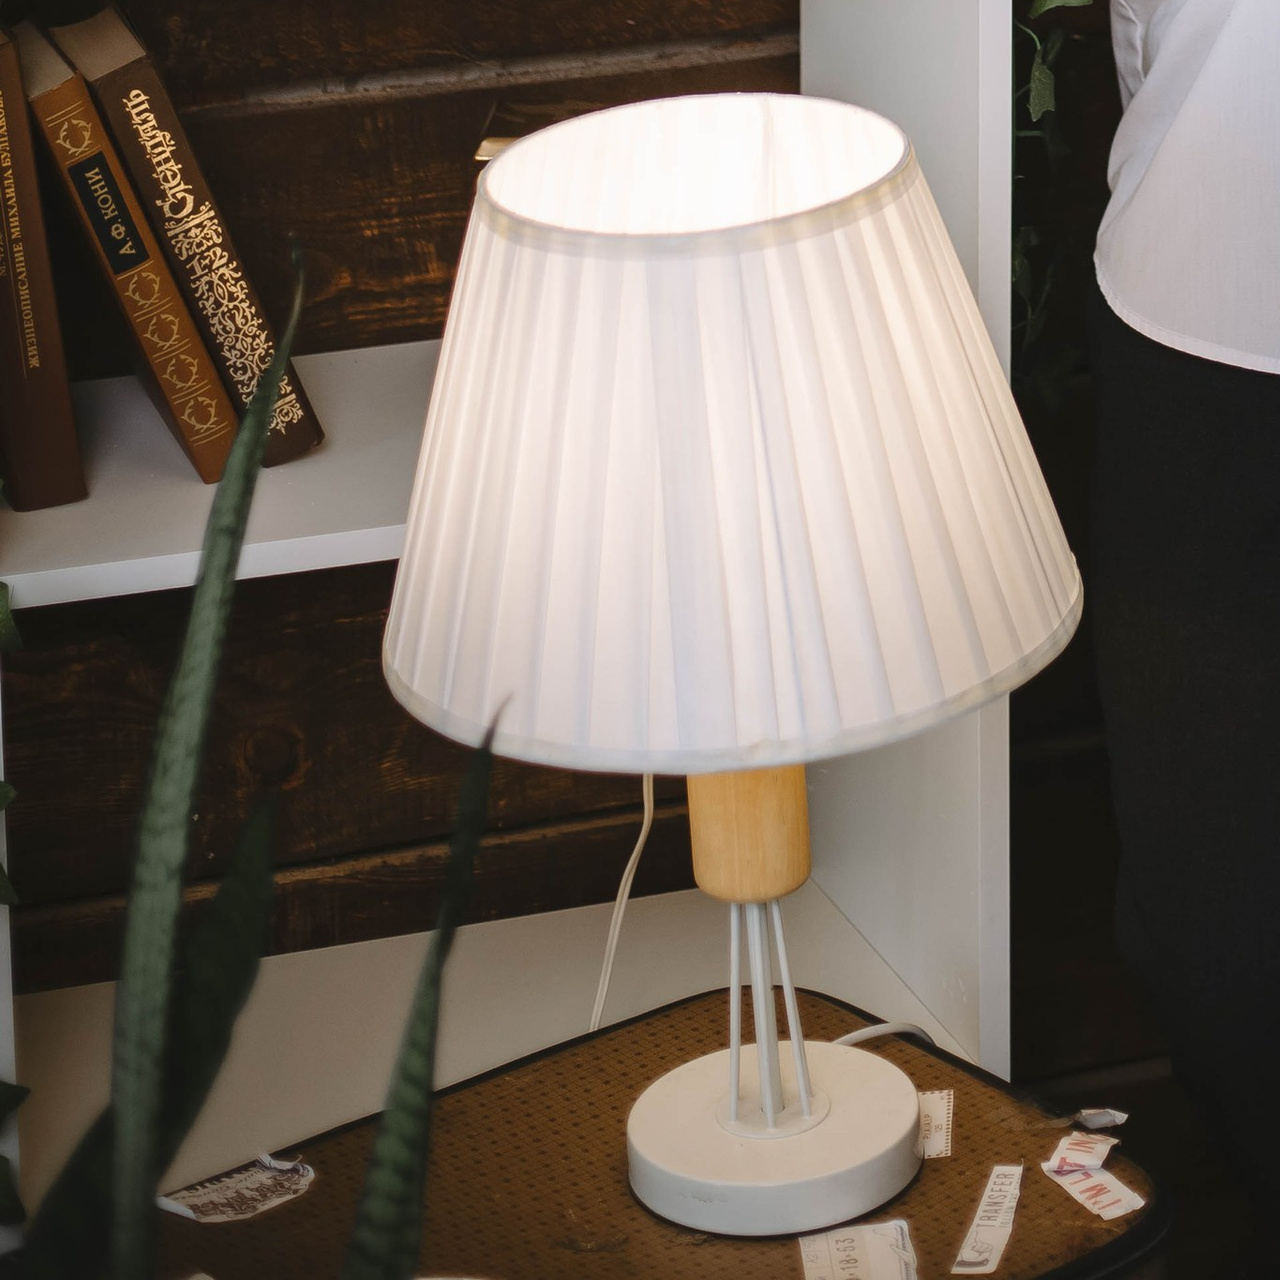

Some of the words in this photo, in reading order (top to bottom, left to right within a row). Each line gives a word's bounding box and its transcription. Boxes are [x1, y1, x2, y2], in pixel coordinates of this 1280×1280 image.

[4, 169, 22, 240] МИХАИЛА
[84, 167, 119, 221] КОНИ
[13, 242, 41, 369] ЖИЗНЕОПИСАНИЕ
[976, 1171, 1016, 1229] TRANSFER
